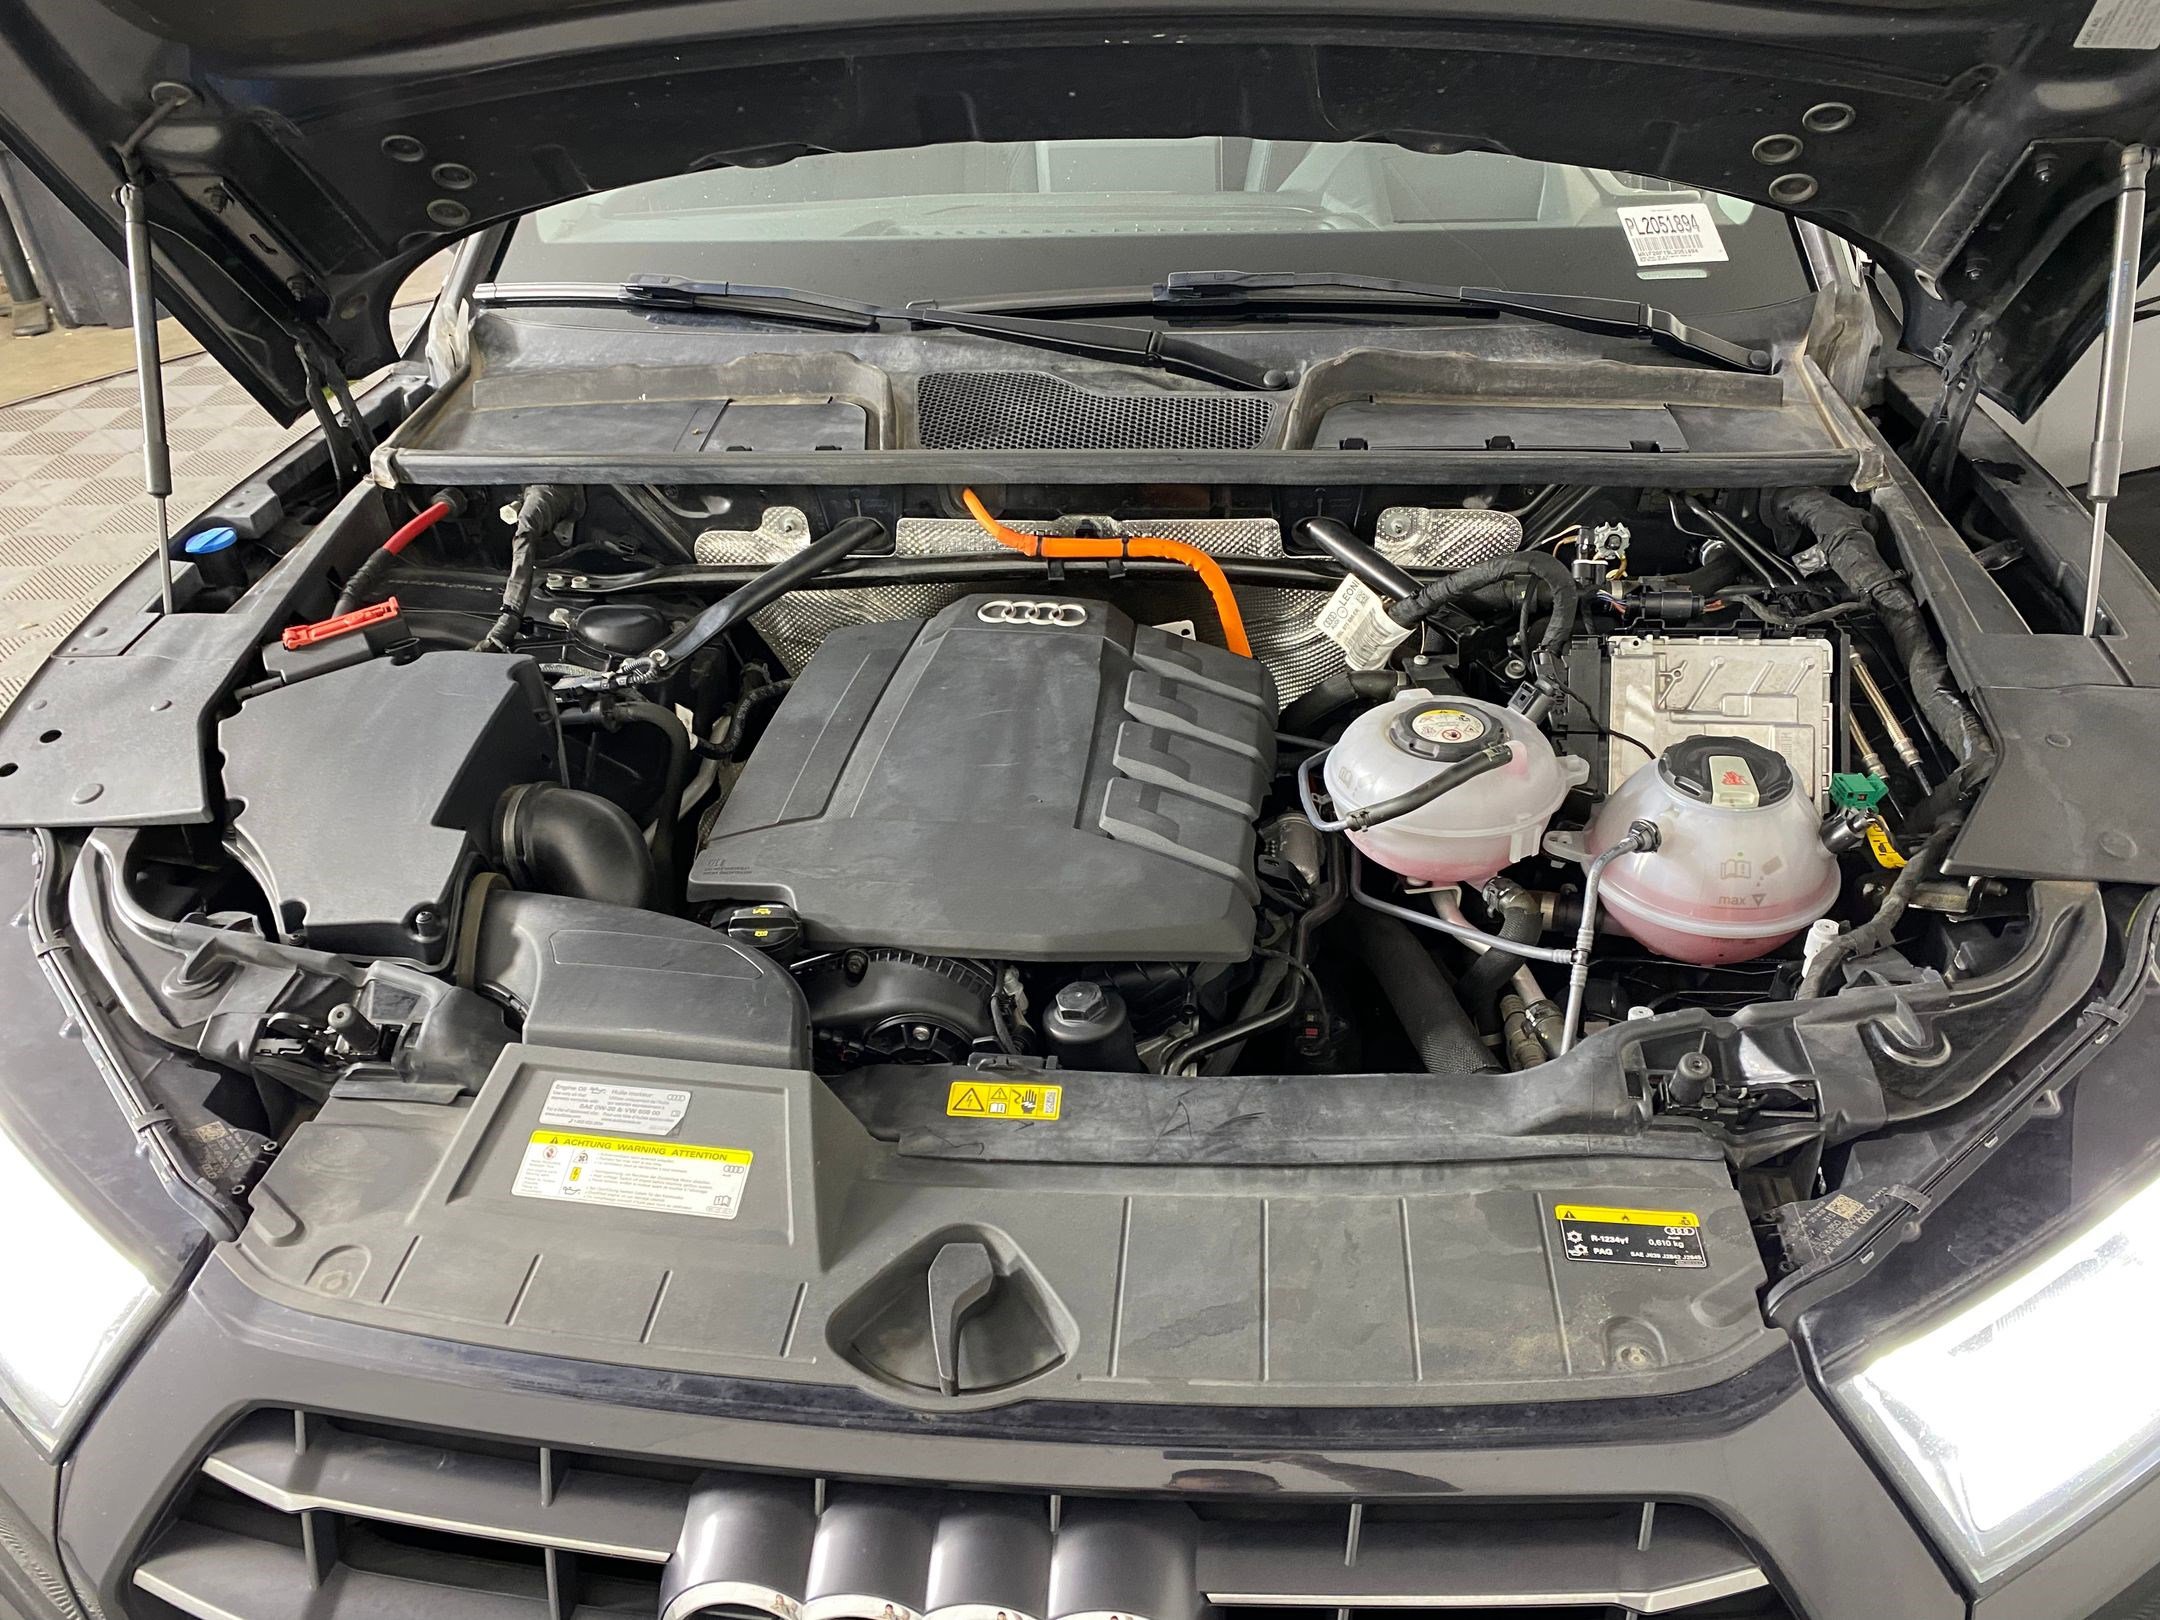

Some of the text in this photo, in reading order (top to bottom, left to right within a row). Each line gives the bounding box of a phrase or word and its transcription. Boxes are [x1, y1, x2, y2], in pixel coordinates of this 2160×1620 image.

[1625, 214, 1700, 236] PL2051894
[1339, 579, 1360, 606] LEONI
[1718, 895, 1746, 905] max
[555, 1083, 577, 1092] Engine
[563, 1138, 728, 1161] ACHTUNG WARNING ATTENTION
[1590, 1235, 1685, 1248] R-1234yf 0,610 kg
[1594, 1247, 1613, 1256] PAG
